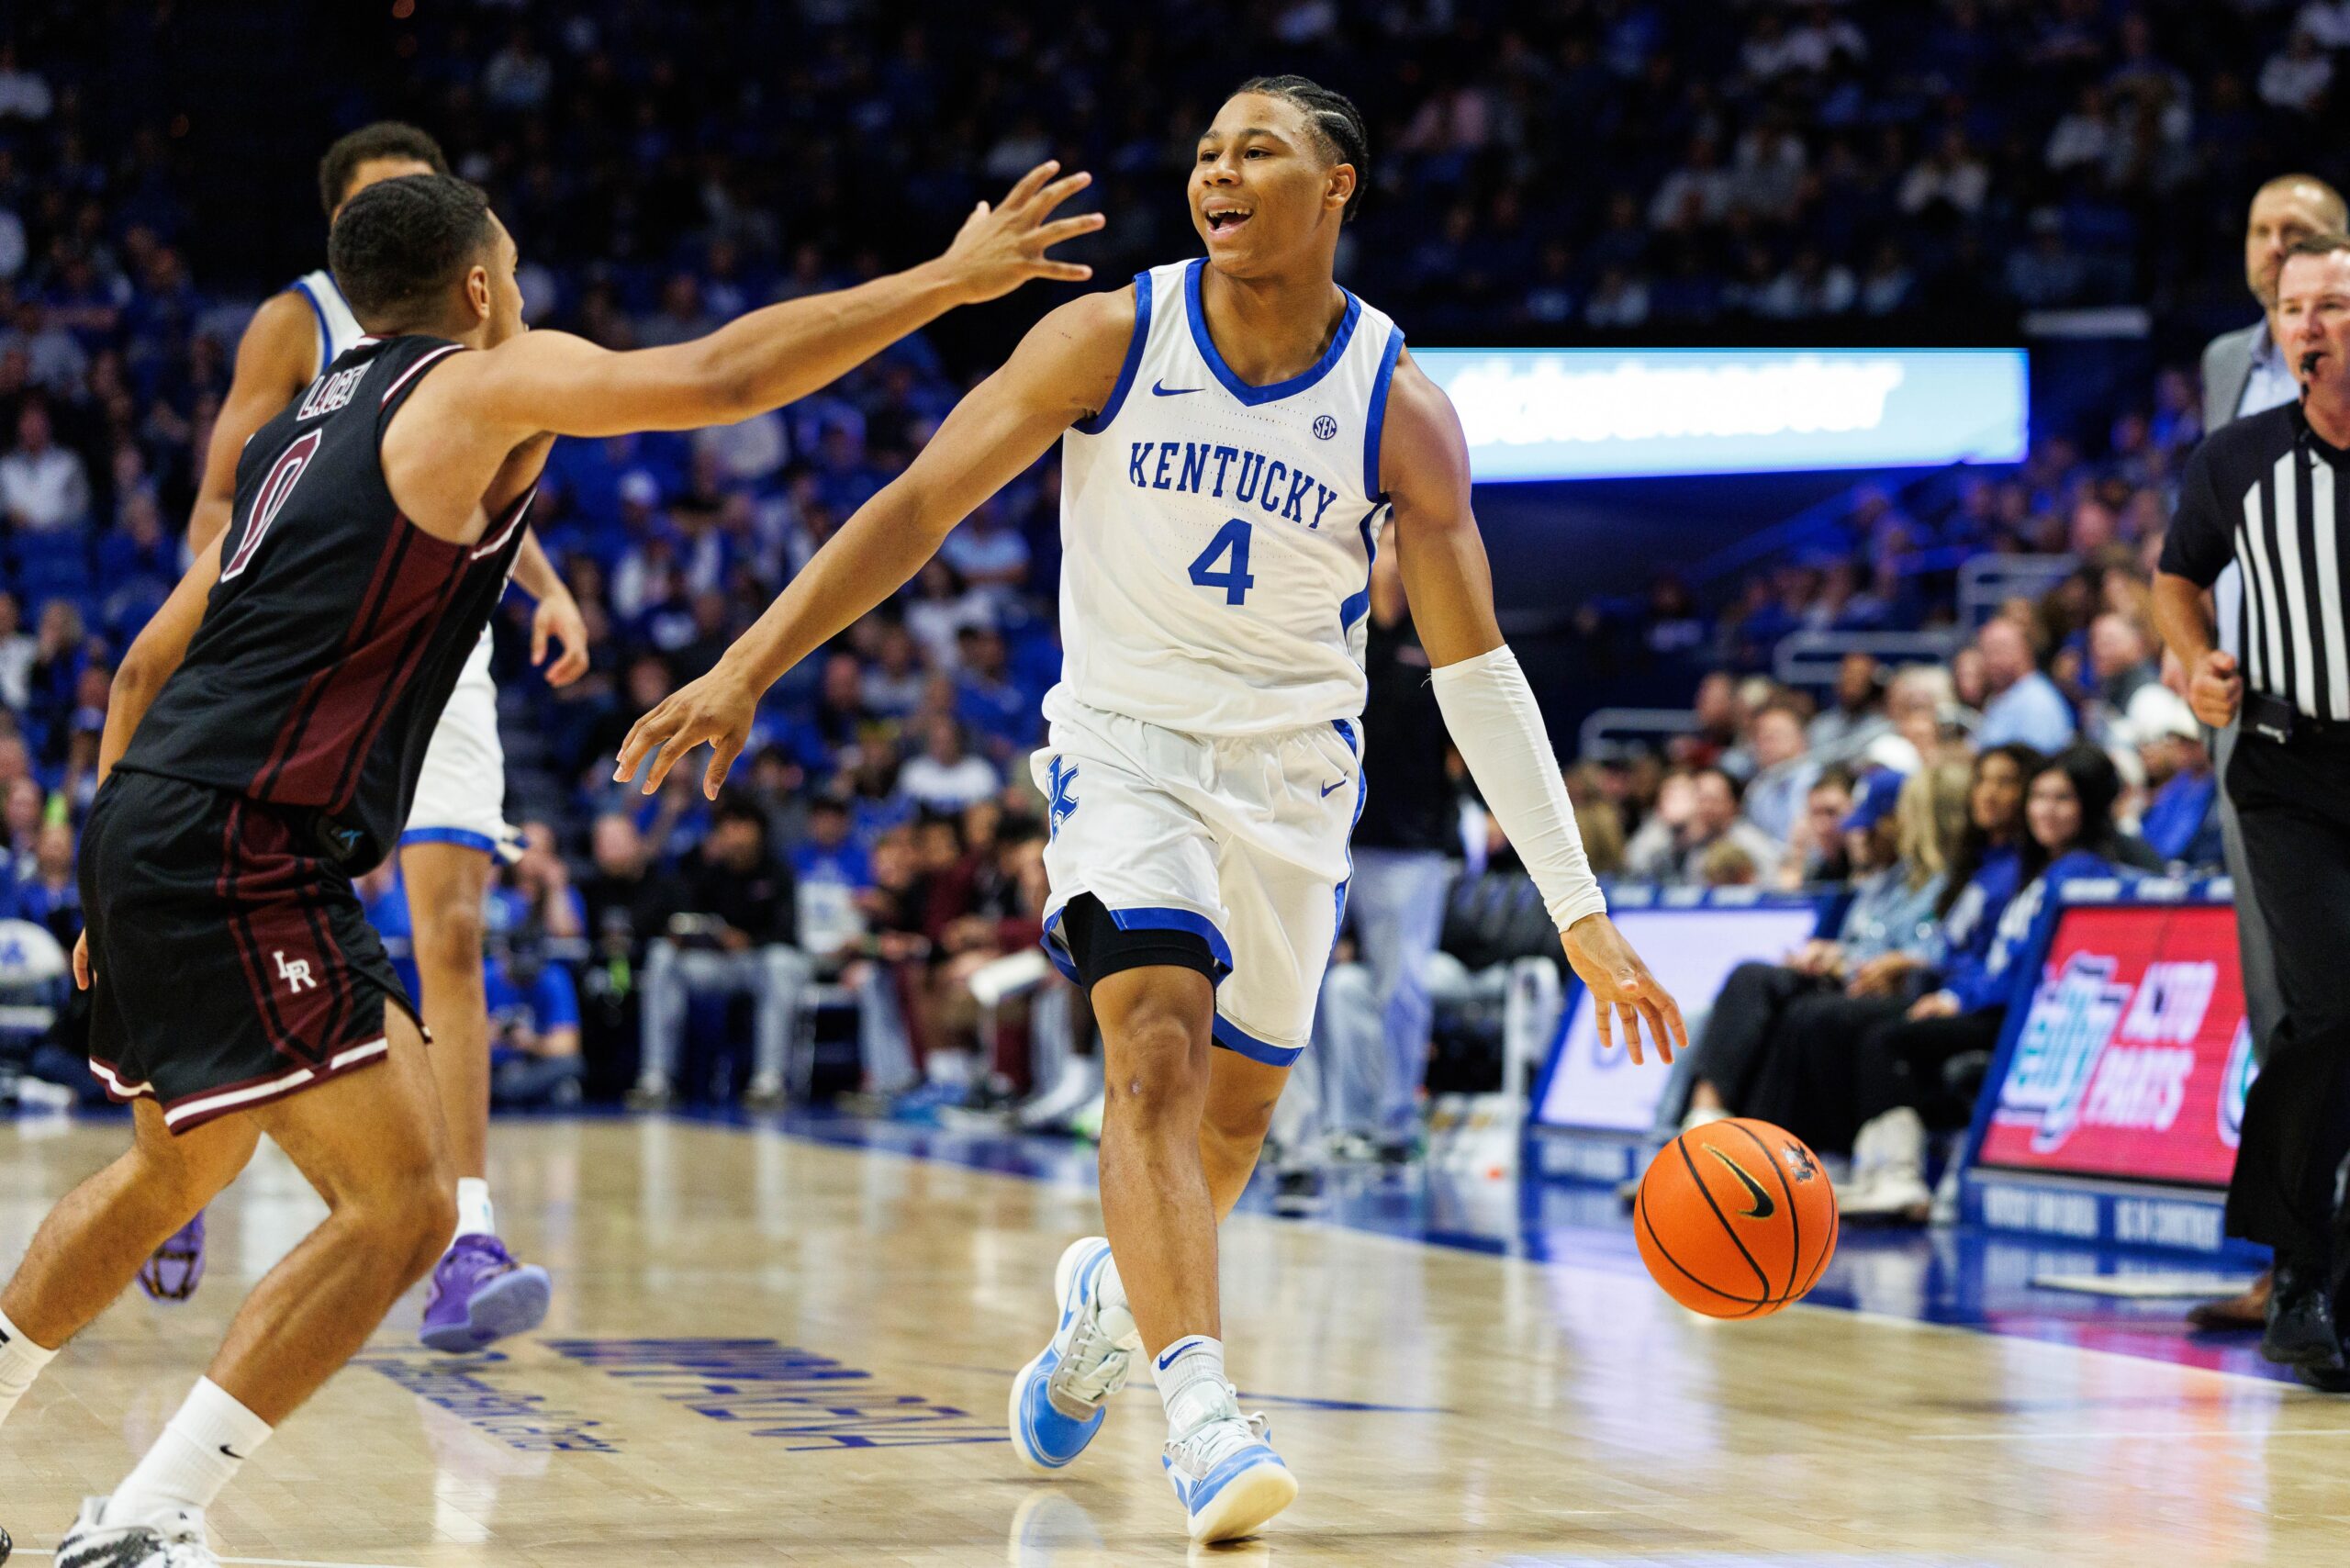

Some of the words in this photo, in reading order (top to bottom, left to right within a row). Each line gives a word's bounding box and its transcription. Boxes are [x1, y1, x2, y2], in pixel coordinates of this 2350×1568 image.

[1313, 415, 1337, 440] SEC
[221, 428, 322, 582] 0
[1129, 442, 1337, 530] KENTUCKY
[1188, 518, 1254, 606] 4
[273, 950, 317, 993] LR
